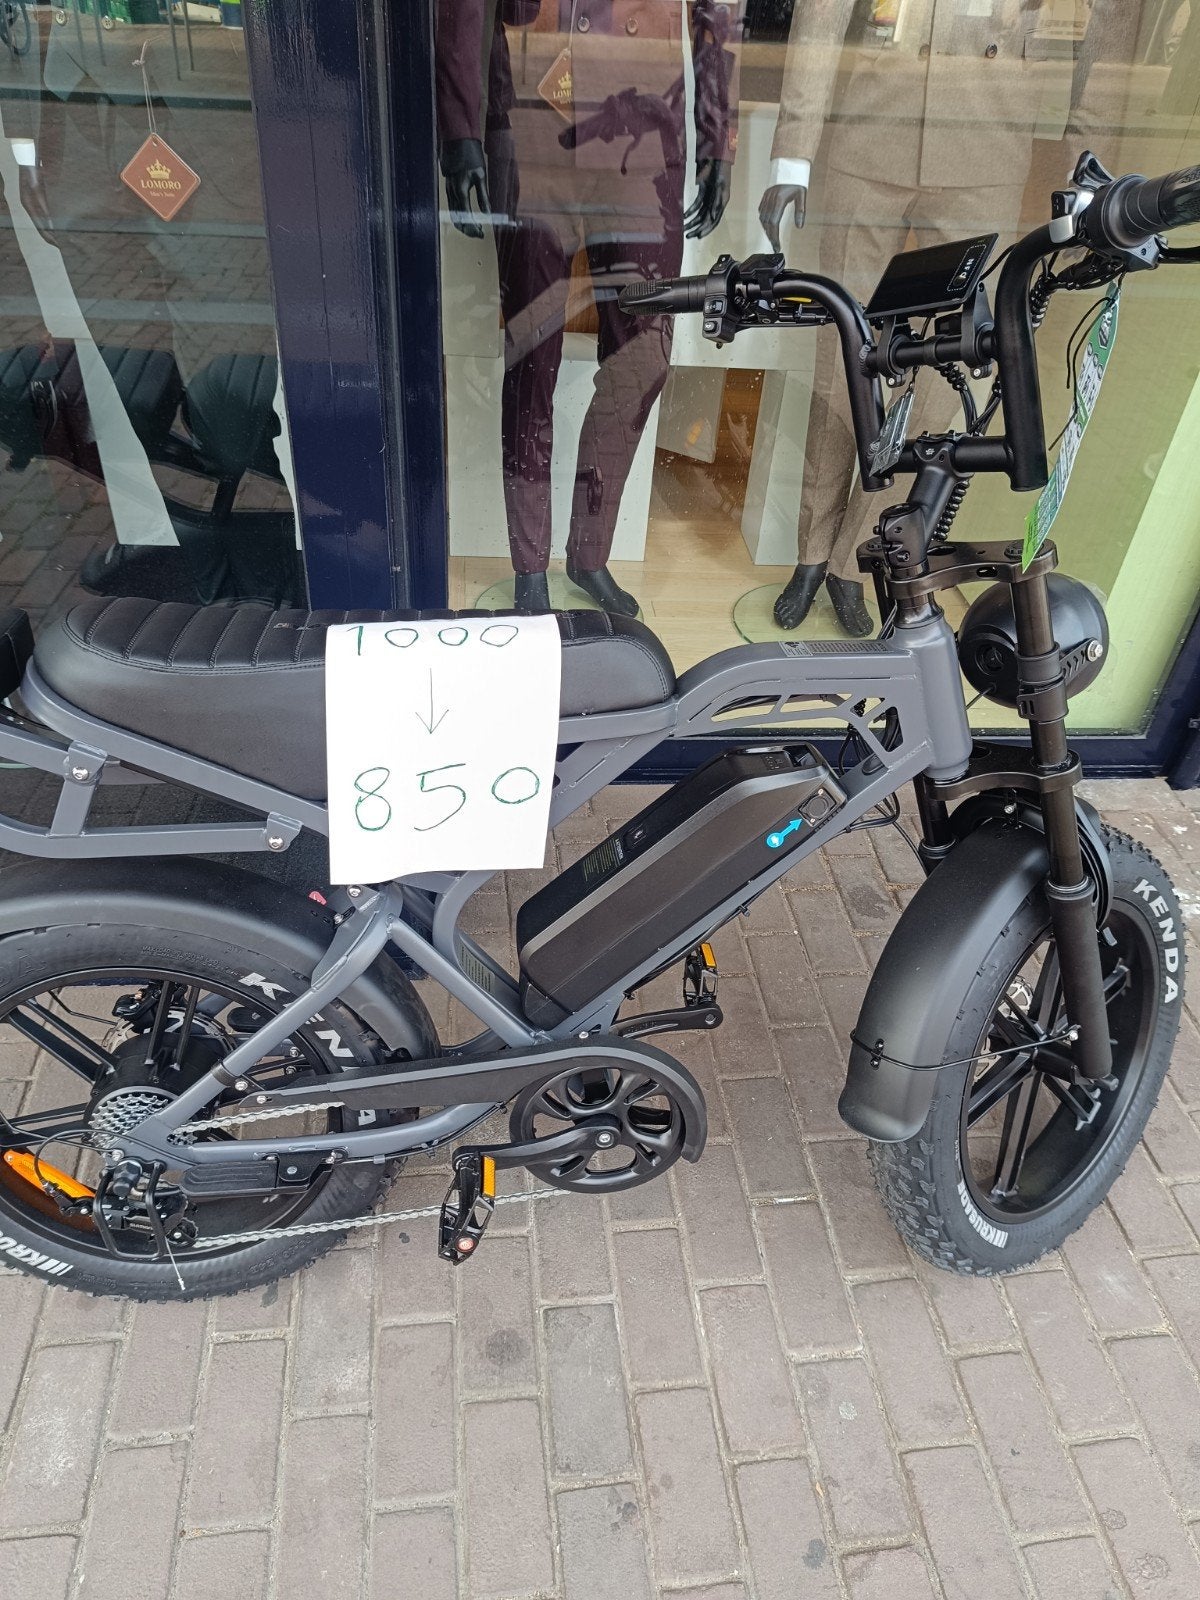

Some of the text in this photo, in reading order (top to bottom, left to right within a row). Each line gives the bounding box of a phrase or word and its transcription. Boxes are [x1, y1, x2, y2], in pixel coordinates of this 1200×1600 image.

[141, 179, 181, 190] LOMORO
[346, 624, 519, 656] 1000
[354, 763, 540, 831] 850
[1132, 878, 1179, 1003] KENDA
[238, 972, 377, 1126] KNA
[0, 1230, 49, 1267] KRU
